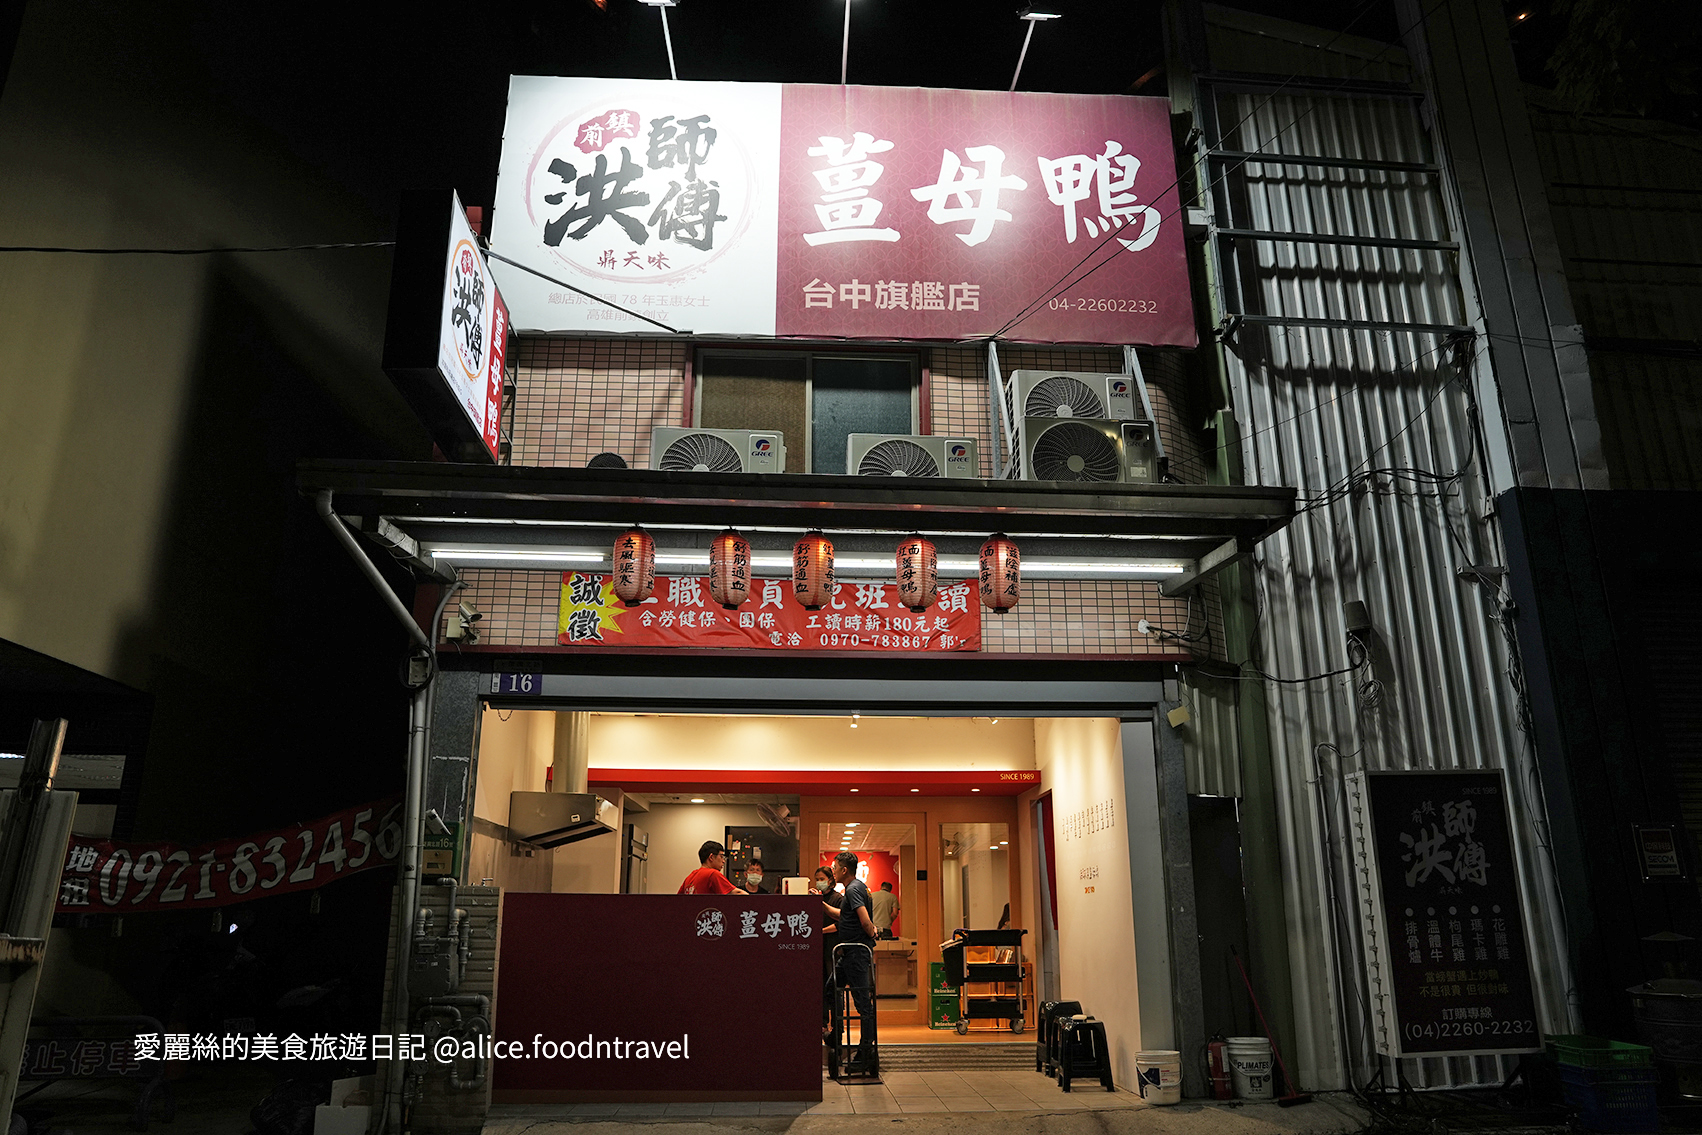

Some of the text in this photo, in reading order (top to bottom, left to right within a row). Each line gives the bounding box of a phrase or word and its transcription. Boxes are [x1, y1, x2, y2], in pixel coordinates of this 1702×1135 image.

[580, 111, 635, 148] 前鎮
[802, 131, 1161, 252] 薑母鴨
[597, 249, 671, 270] 鼎天味
[622, 294, 638, 304] 78
[802, 278, 980, 311] 台中旗艦店
[1049, 298, 1158, 314] 04-22602232
[486, 307, 505, 448] 薑母鴨
[568, 574, 605, 642] 誠徵
[819, 633, 931, 648] 0970-783867
[509, 674, 533, 692] 16
[1000, 773, 1019, 781] SINCE
[1462, 787, 1481, 795] SINCE
[99, 802, 401, 906] 0921-832456
[739, 910, 812, 939] 薑母鴨
[1405, 1020, 1534, 1041] (04)2260-2232
[20, 1040, 140, 1075] 止停車
